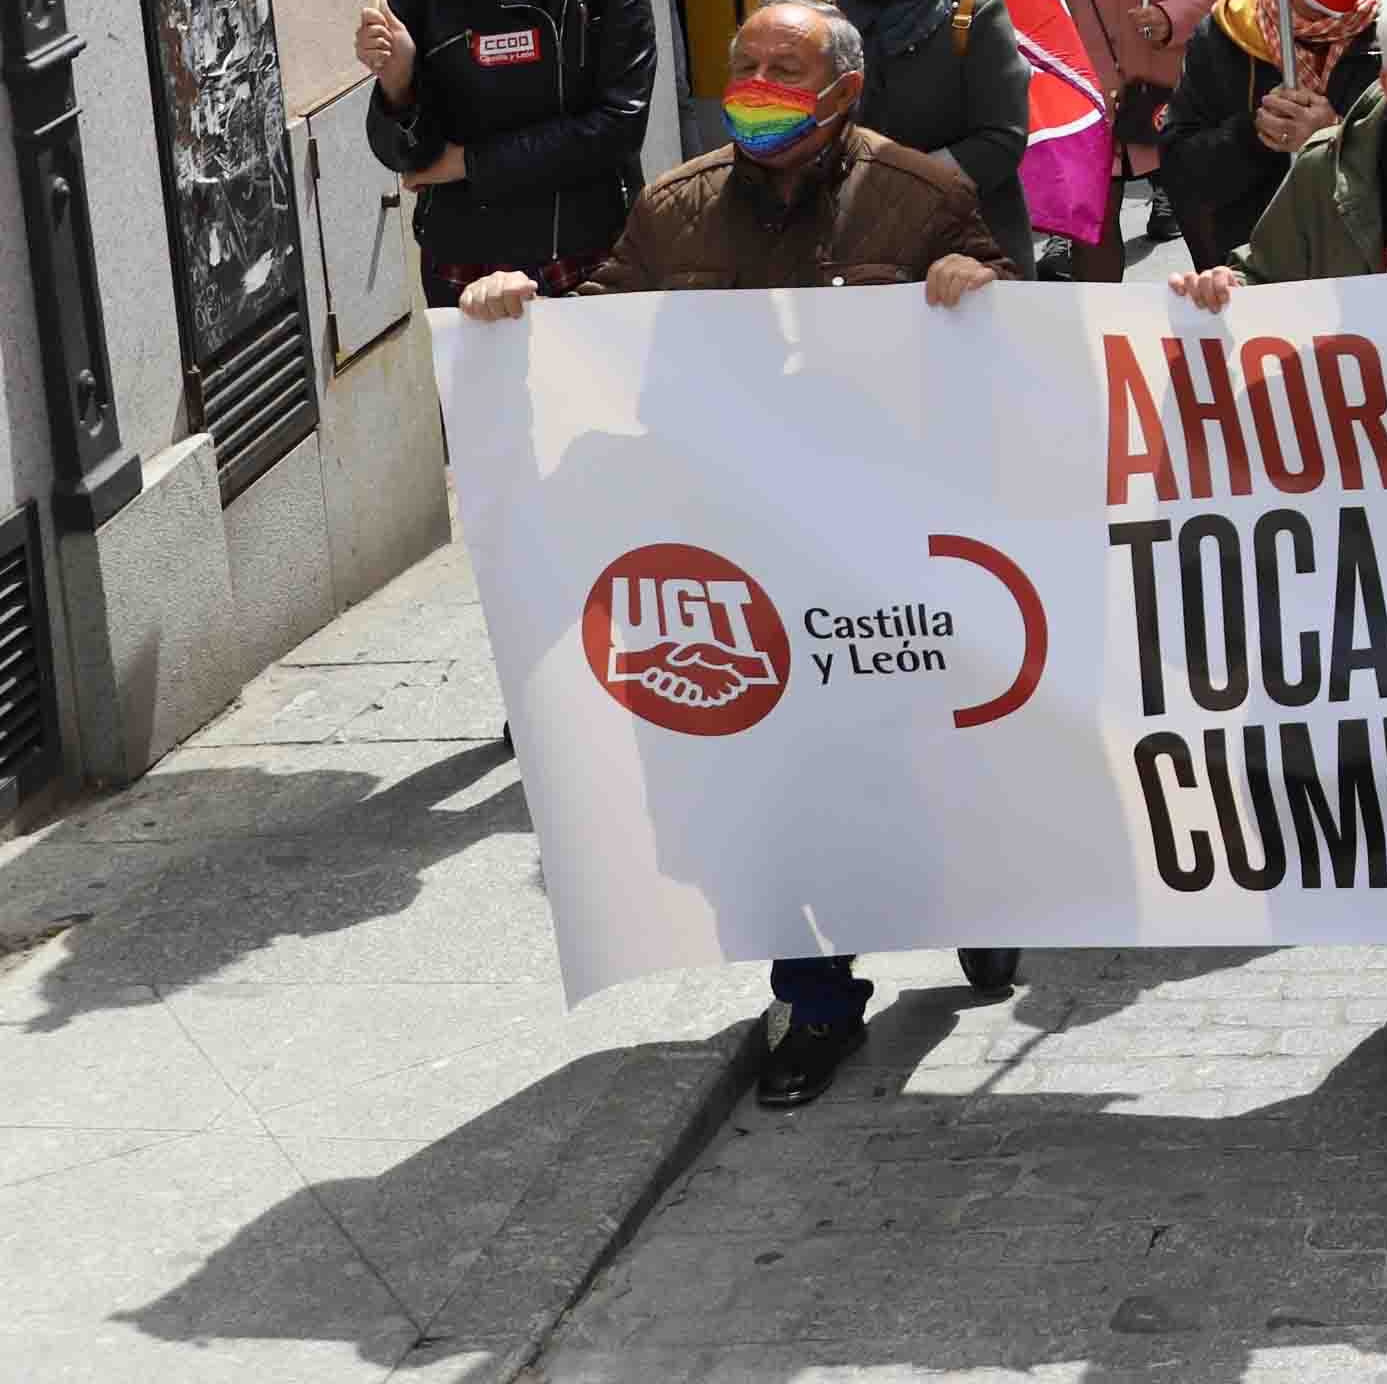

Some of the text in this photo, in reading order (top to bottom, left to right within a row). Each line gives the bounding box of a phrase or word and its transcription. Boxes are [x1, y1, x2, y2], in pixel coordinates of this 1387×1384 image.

[485, 36, 529, 51] CCOO
[611, 576, 754, 652] UGT
[803, 603, 953, 640] Castilla
[810, 639, 946, 687] y León
